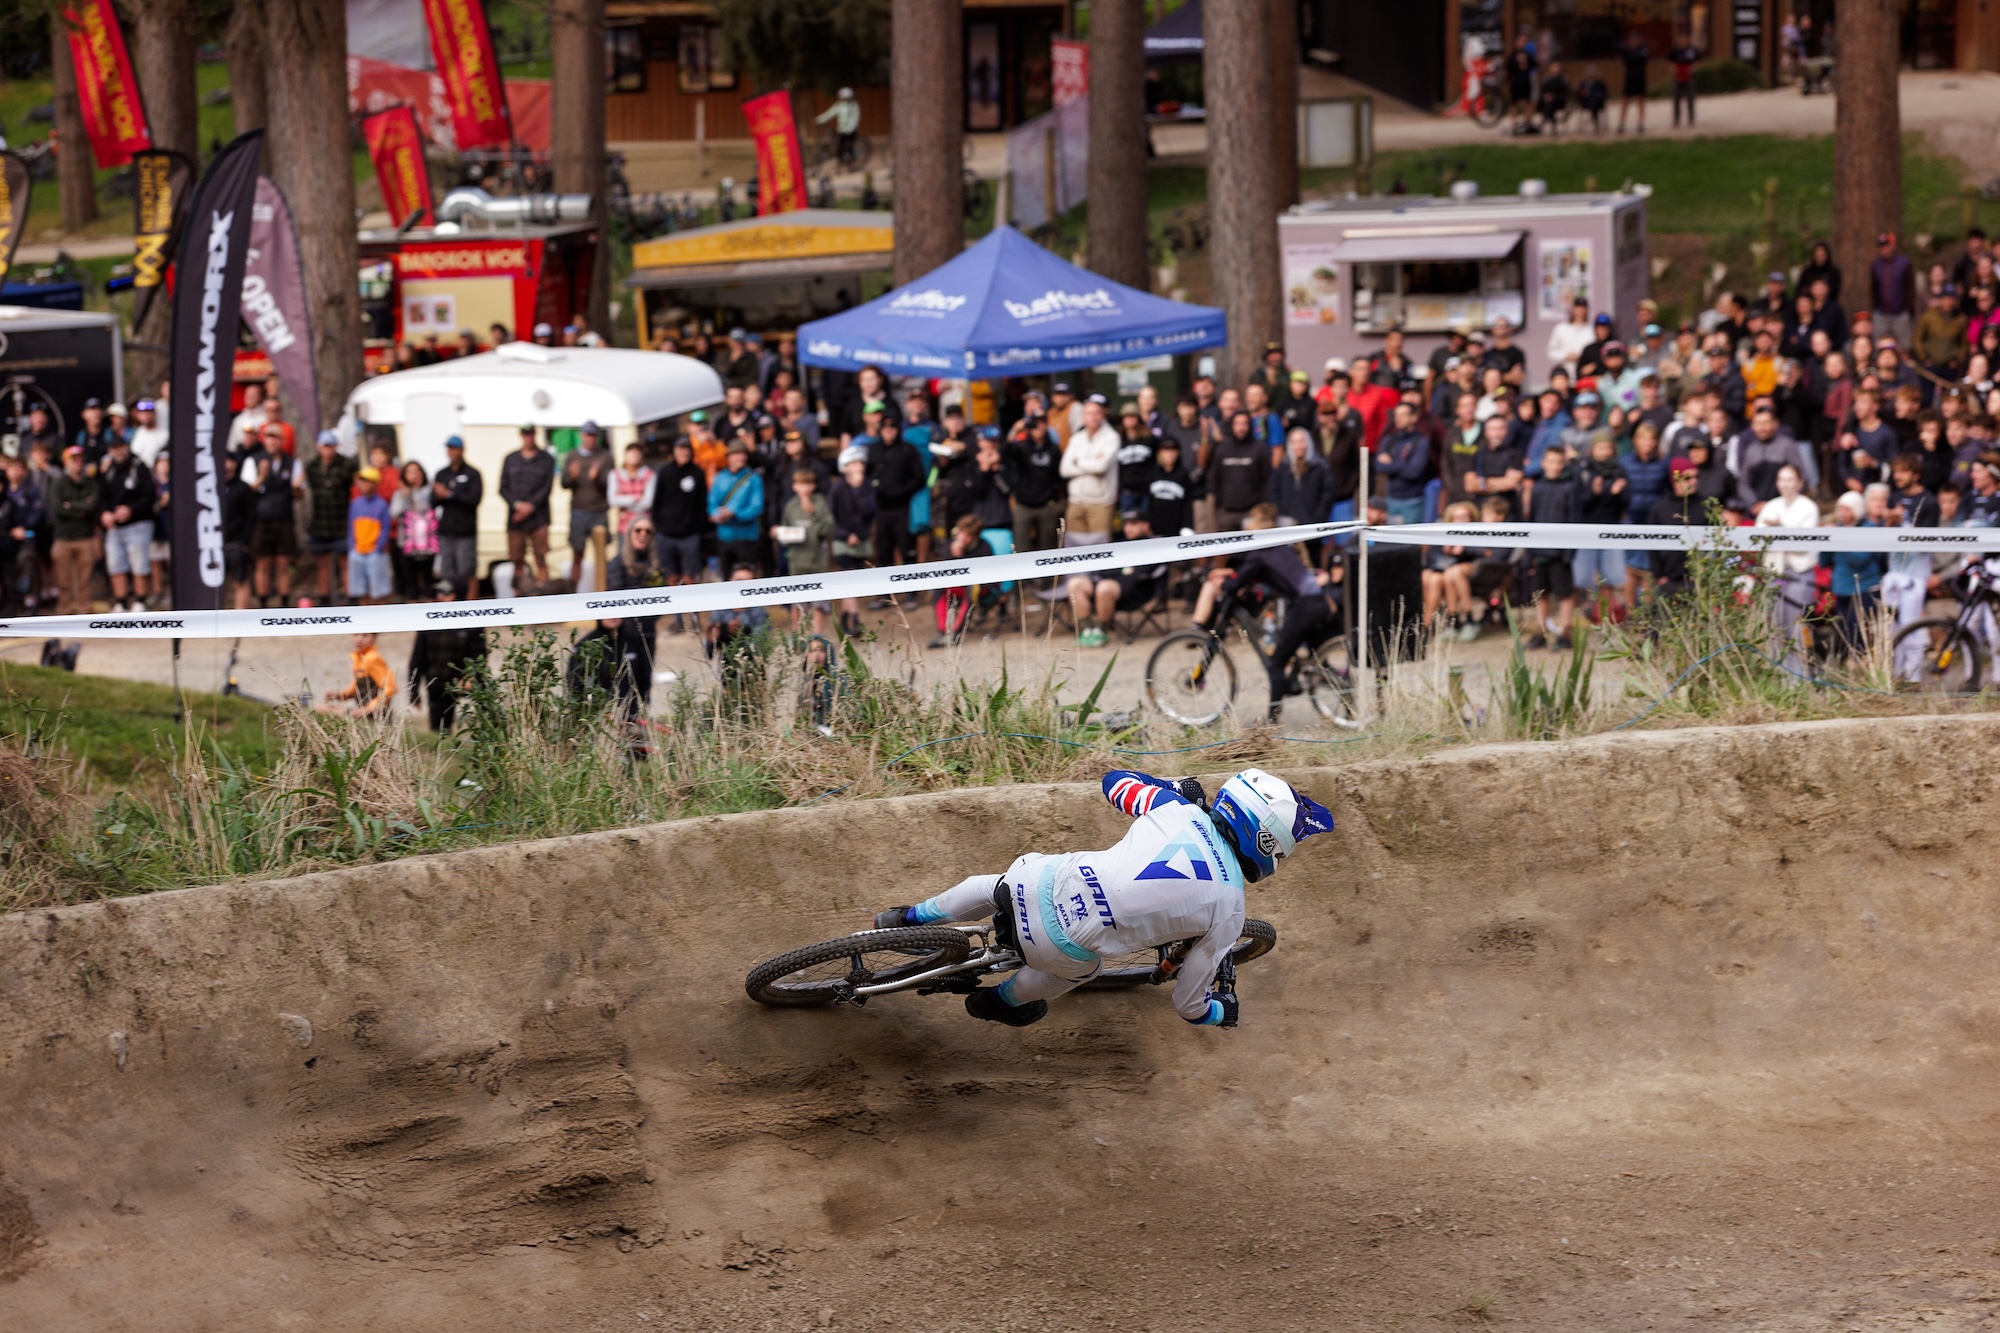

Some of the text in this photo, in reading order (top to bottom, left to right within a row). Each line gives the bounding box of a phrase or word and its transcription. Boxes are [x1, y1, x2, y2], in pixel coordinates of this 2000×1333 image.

[241, 274, 296, 354] OPEN
[195, 208, 235, 589] CRANKWORX
[1177, 533, 1255, 550] CRANKWORX
[1446, 529, 1531, 538] CRANKWORX
[1598, 532, 1682, 540] CRANKWORX
[1035, 550, 1114, 567] CRANKWORX
[890, 567, 971, 582] CRANKWORX
[740, 582, 823, 597] CRANKWORX
[586, 595, 672, 609] CRANKWORX
[260, 615, 352, 626] CRANKWORX
[426, 607, 515, 620] CRANKWORX
[89, 619, 184, 629] CRANKWORX
[1191, 819, 1230, 882] MEIER-SMITH
[1078, 865, 1118, 930] GIANT
[1016, 883, 1037, 946] GIANT
[1057, 903, 1071, 928] MAXXIS
[1070, 893, 1089, 922] FOX
